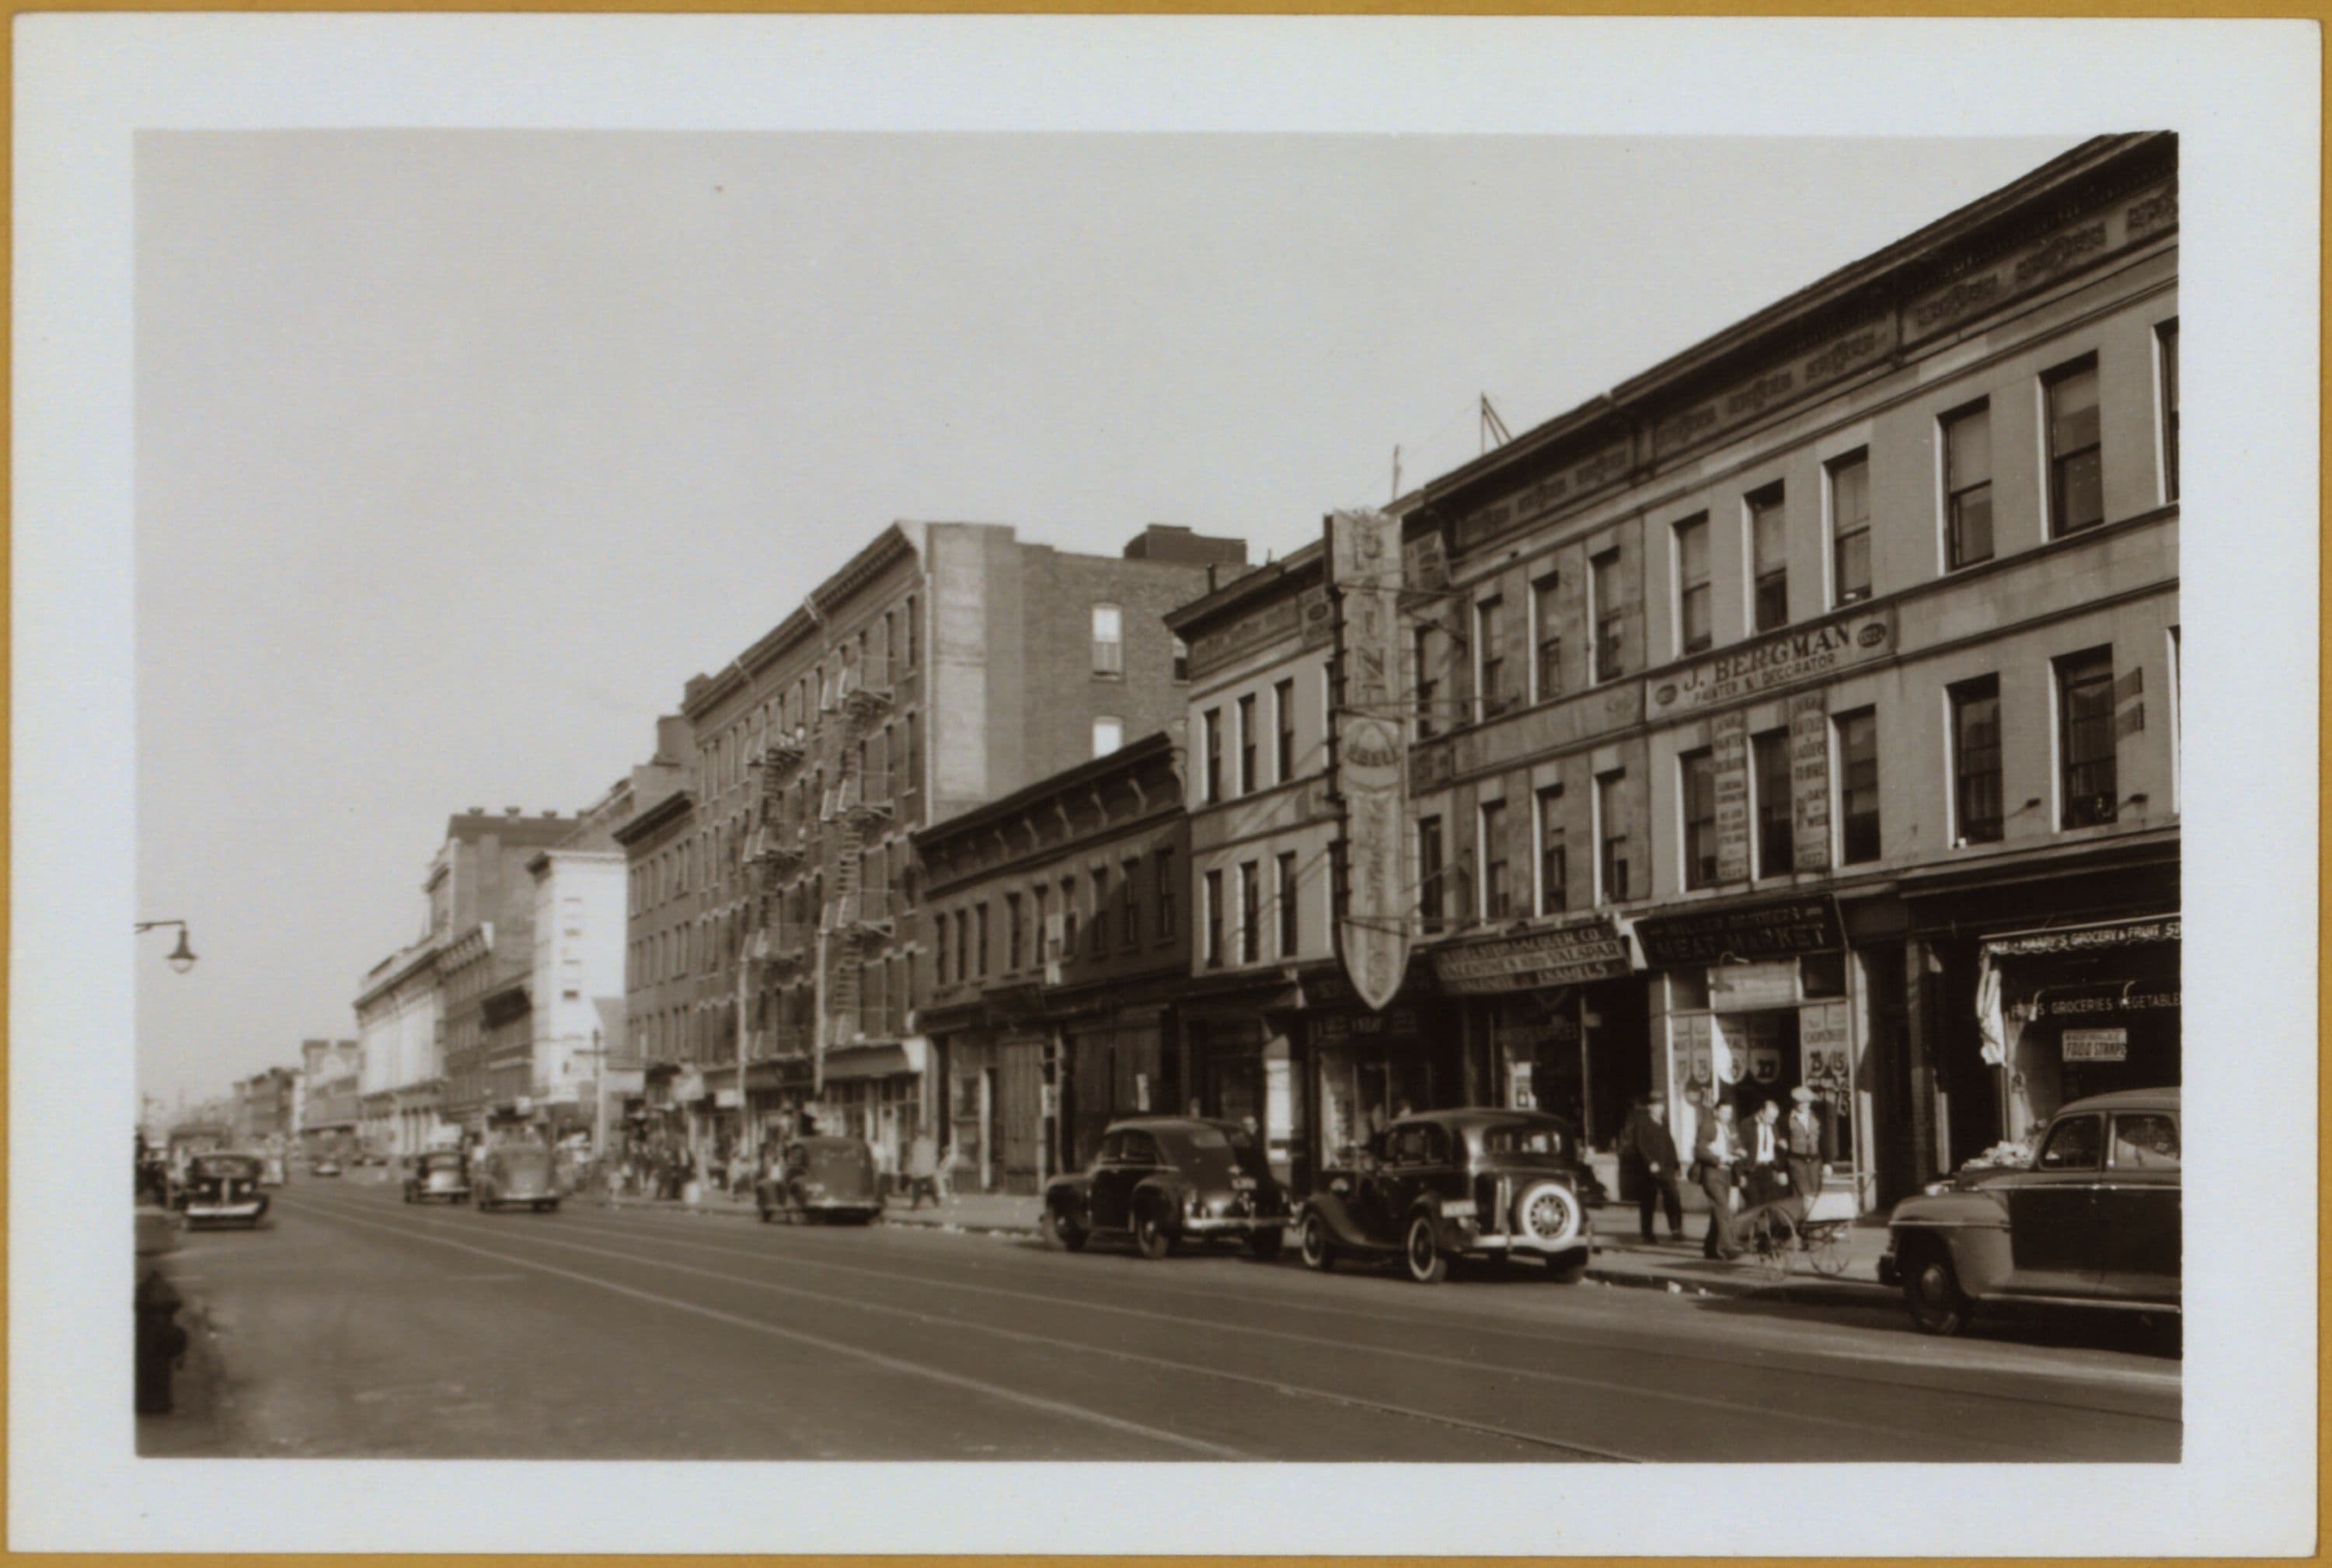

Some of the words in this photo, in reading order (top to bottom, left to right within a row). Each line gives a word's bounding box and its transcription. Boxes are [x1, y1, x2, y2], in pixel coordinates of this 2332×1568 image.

[1683, 668, 1705, 692] J.
[1714, 621, 1850, 684] BERGMAN
[1694, 678, 1738, 703] PAINTER
[1761, 653, 1835, 687] DECORATOR
[1578, 929, 1602, 942] CO.
[1654, 935, 1717, 960] MEAT
[1723, 922, 1825, 956] MARKET
[2070, 929, 2117, 946] GROCERY
[2128, 925, 2159, 939] FRUIT
[1547, 942, 1621, 964] VALSPAR
[1537, 963, 1608, 986] ENAMELS
[2051, 998, 2114, 1015] GROCERIES
[2067, 1042, 2092, 1057] FOOD
